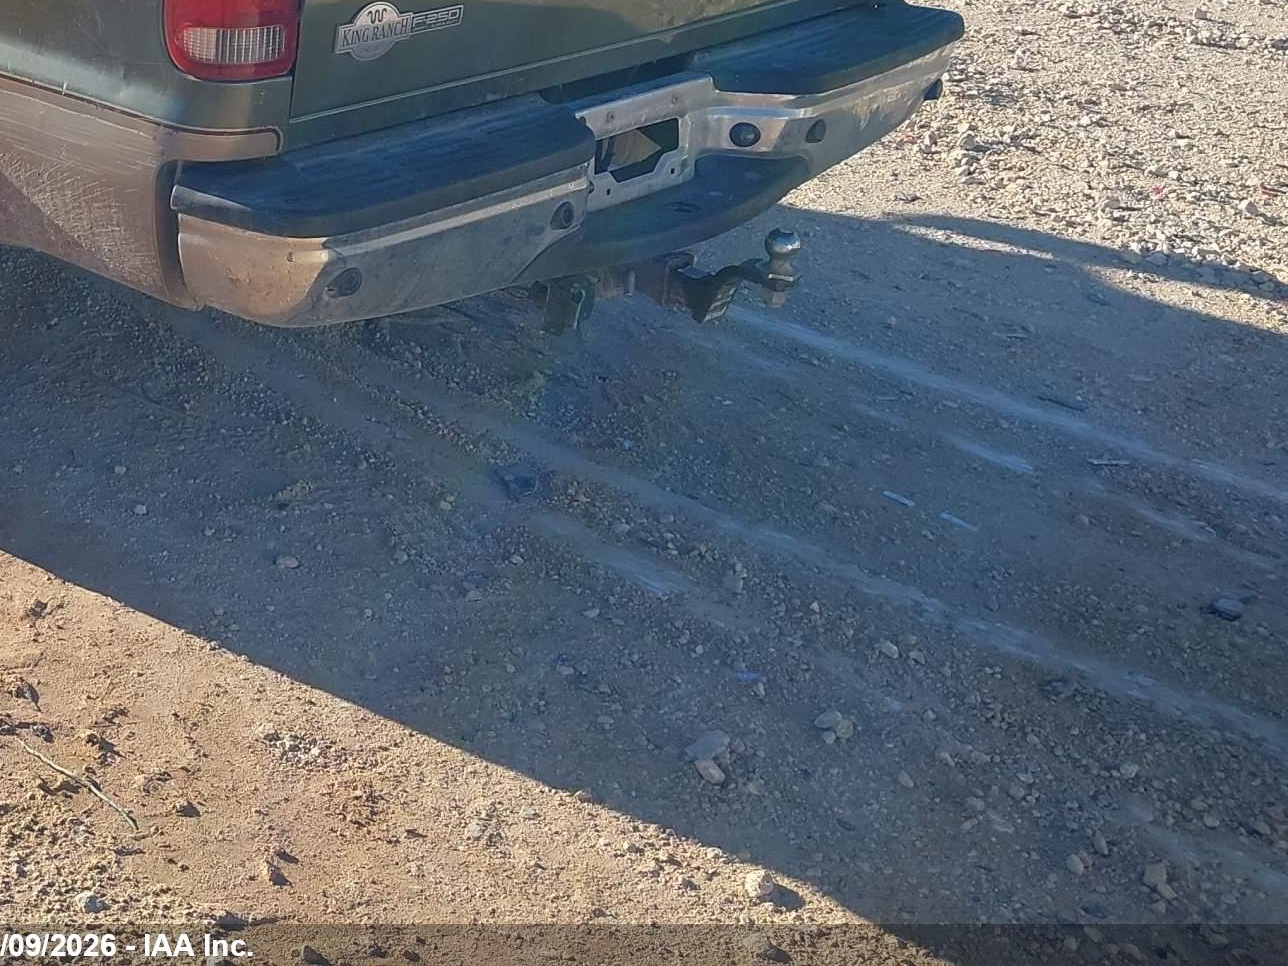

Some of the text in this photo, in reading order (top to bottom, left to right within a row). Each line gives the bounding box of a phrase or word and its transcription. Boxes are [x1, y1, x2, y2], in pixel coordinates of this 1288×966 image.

[413, 9, 460, 27] F-250
[342, 28, 369, 46] KING
[372, 17, 409, 40] RANCH
